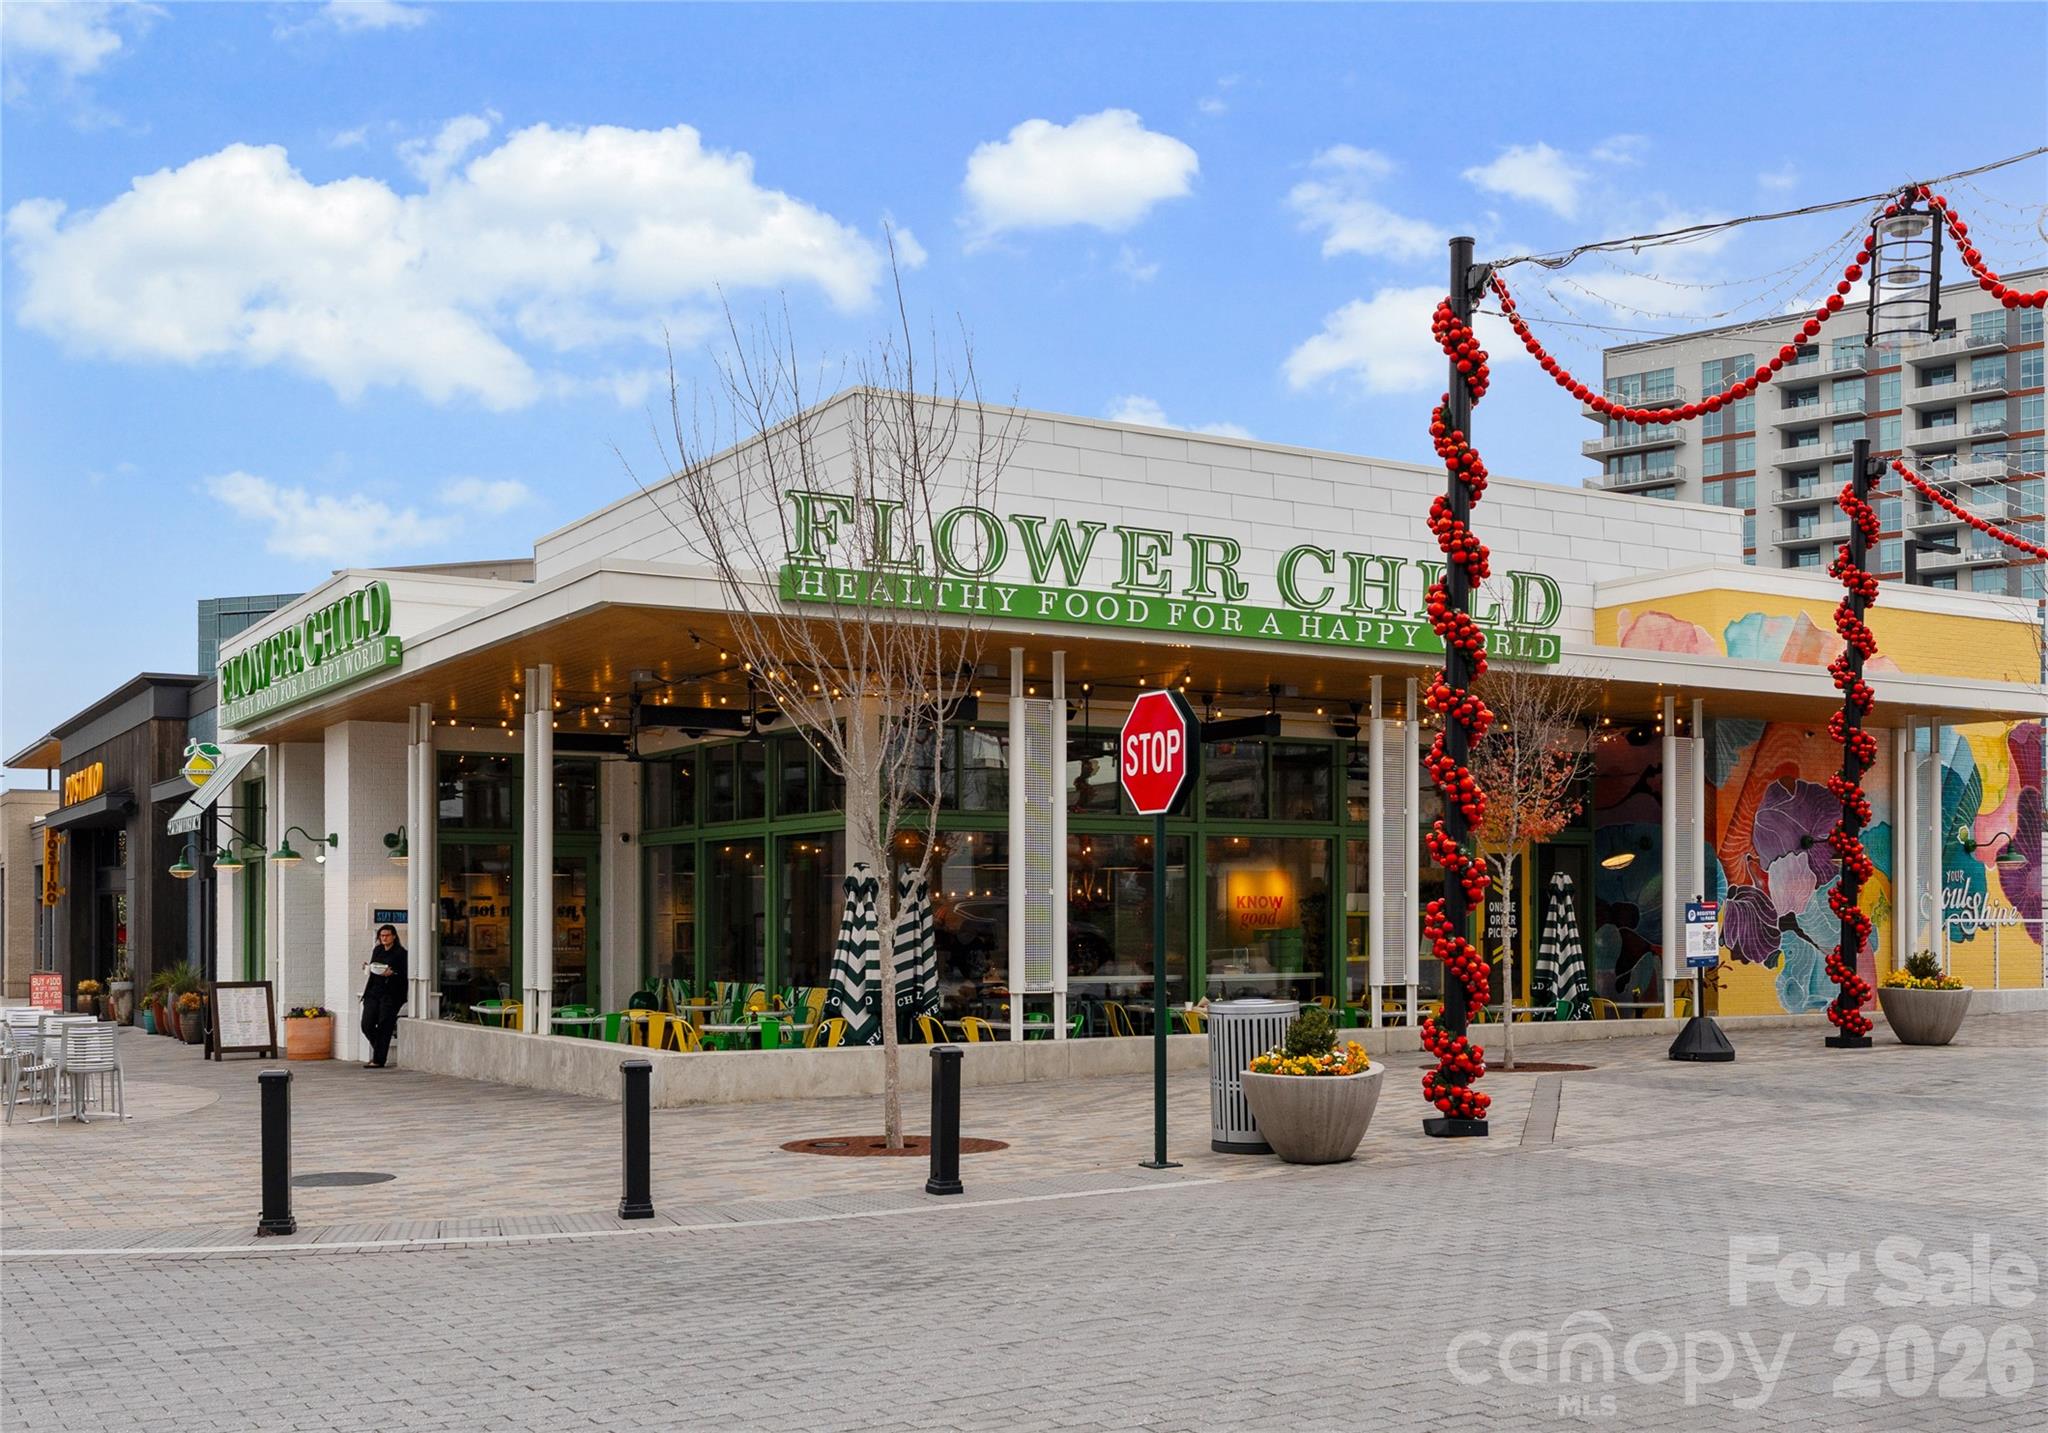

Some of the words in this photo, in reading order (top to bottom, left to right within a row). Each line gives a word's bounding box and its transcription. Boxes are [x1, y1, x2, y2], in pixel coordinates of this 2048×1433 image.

[784, 489, 1249, 601] FLOWER
[797, 569, 1018, 612] HEALTHY
[1038, 590, 1149, 624] FOOD
[1167, 603, 1243, 632] FOR
[1259, 612, 1283, 635] A
[1299, 615, 1421, 647] HAPPY
[1439, 633, 1556, 659] RLD
[220, 624, 304, 705] FLOWER
[304, 580, 391, 667] CHILD
[222, 698, 254, 725] HEALTHY
[256, 689, 278, 712] FOOD
[281, 679, 298, 702] FOR
[300, 677, 307, 693] A
[309, 664, 341, 690] HAPPY
[343, 641, 384, 674] WORLD
[1125, 729, 1181, 777] STOP
[1945, 869, 1965, 883] YOUR
[1236, 895, 1284, 909] KNOW
[1488, 901, 1516, 913] ONLE
[1489, 914, 1516, 925] ORR
[1961, 892, 2018, 935] Shine
